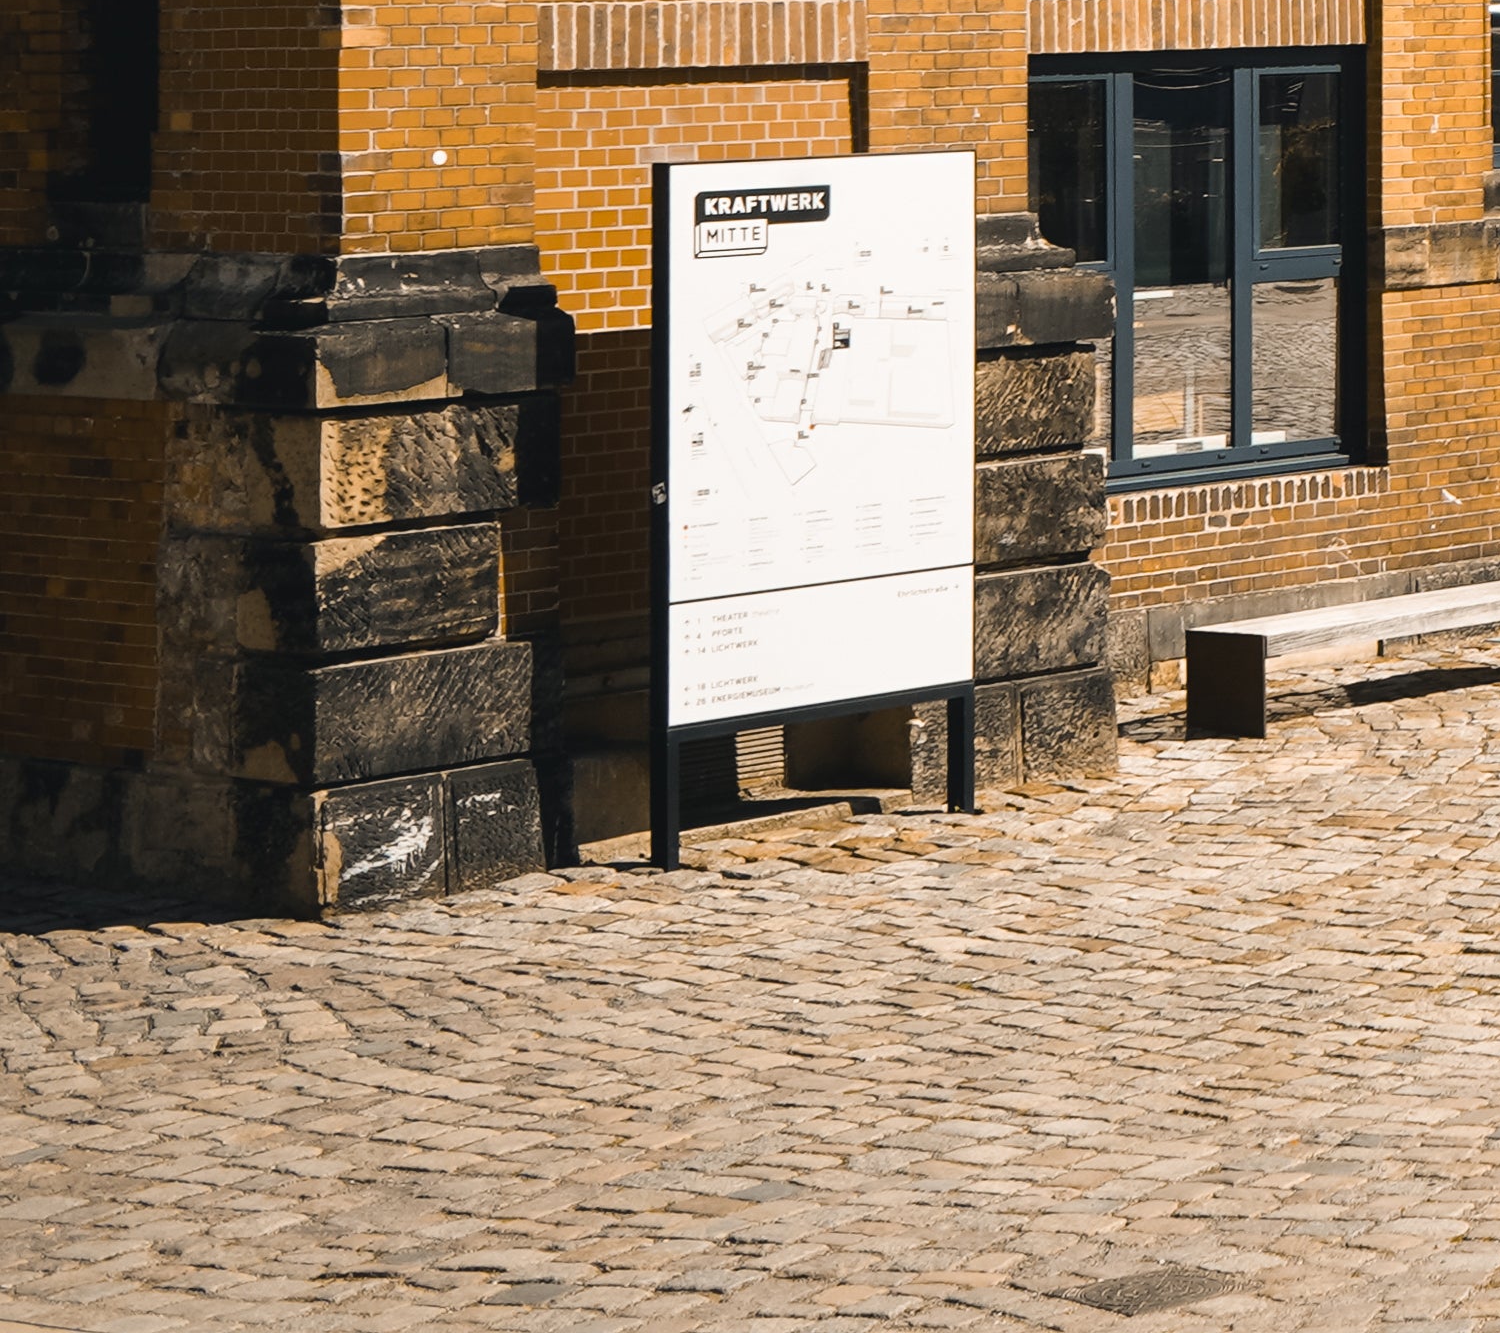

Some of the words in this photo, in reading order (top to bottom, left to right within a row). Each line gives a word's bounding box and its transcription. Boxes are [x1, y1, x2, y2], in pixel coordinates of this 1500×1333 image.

[704, 191, 826, 216] KRAFTWERK
[706, 226, 761, 244] MITTE
[712, 611, 749, 623] THEATER
[711, 639, 759, 654] LICHTWERK
[711, 675, 759, 690] LICHTWERK
[711, 686, 781, 704] ENERGIEMUSEUM
